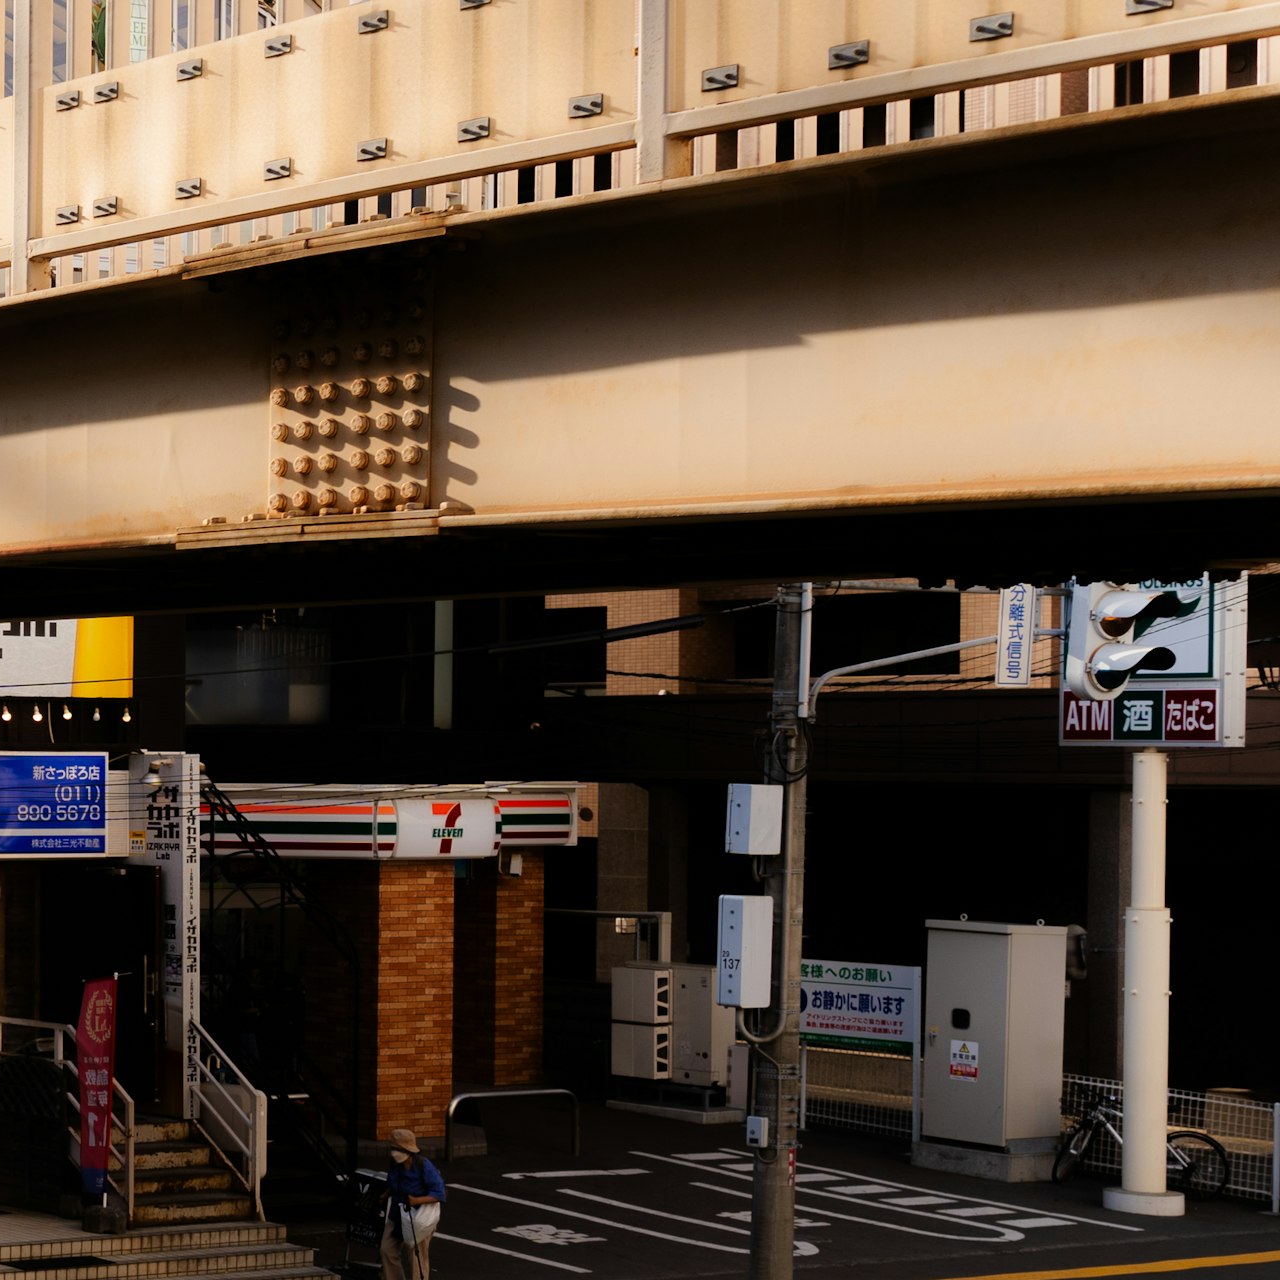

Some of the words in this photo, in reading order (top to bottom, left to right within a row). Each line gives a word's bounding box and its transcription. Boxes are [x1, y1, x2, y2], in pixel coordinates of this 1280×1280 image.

[1005, 583, 1027, 680] 分離式信号
[1065, 700, 1110, 731] ATM
[1122, 699, 1154, 732] 酒
[1166, 698, 1215, 732] たばこ
[32, 765, 101, 781] 新さっぽろ店
[55, 784, 101, 803] (011)
[31, 838, 101, 849] 株式会社三光不動産
[146, 843, 180, 851] IZAKAYA
[156, 852, 171, 860] Lab
[722, 958, 740, 970] 137
[811, 990, 905, 1015] お静かに願います
